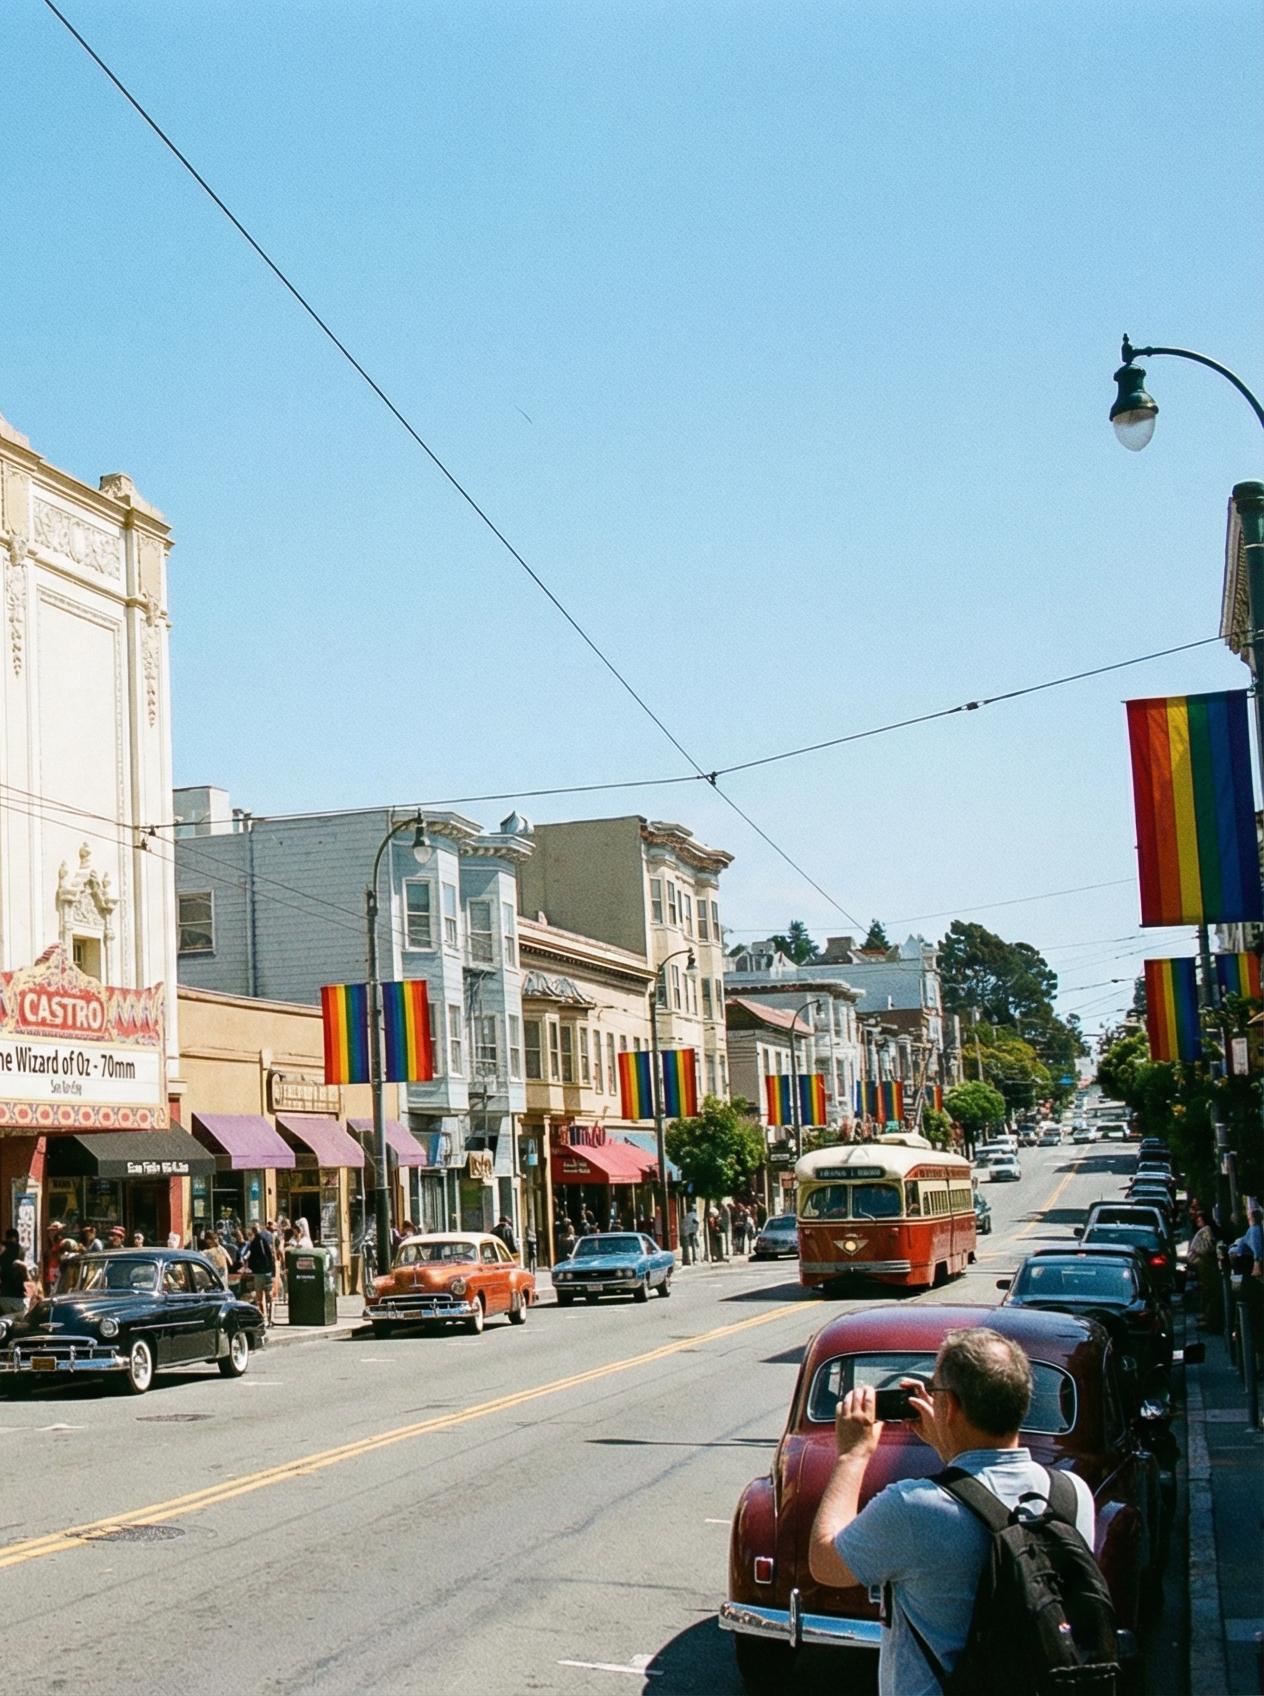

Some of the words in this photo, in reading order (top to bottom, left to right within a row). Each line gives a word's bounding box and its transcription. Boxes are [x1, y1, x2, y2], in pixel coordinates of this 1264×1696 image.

[23, 992, 103, 1030] CASTRO
[15, 1046, 59, 1075] Wizard
[62, 1050, 75, 1076] of
[76, 1051, 91, 1077] Oz
[100, 1054, 136, 1079] 70mm
